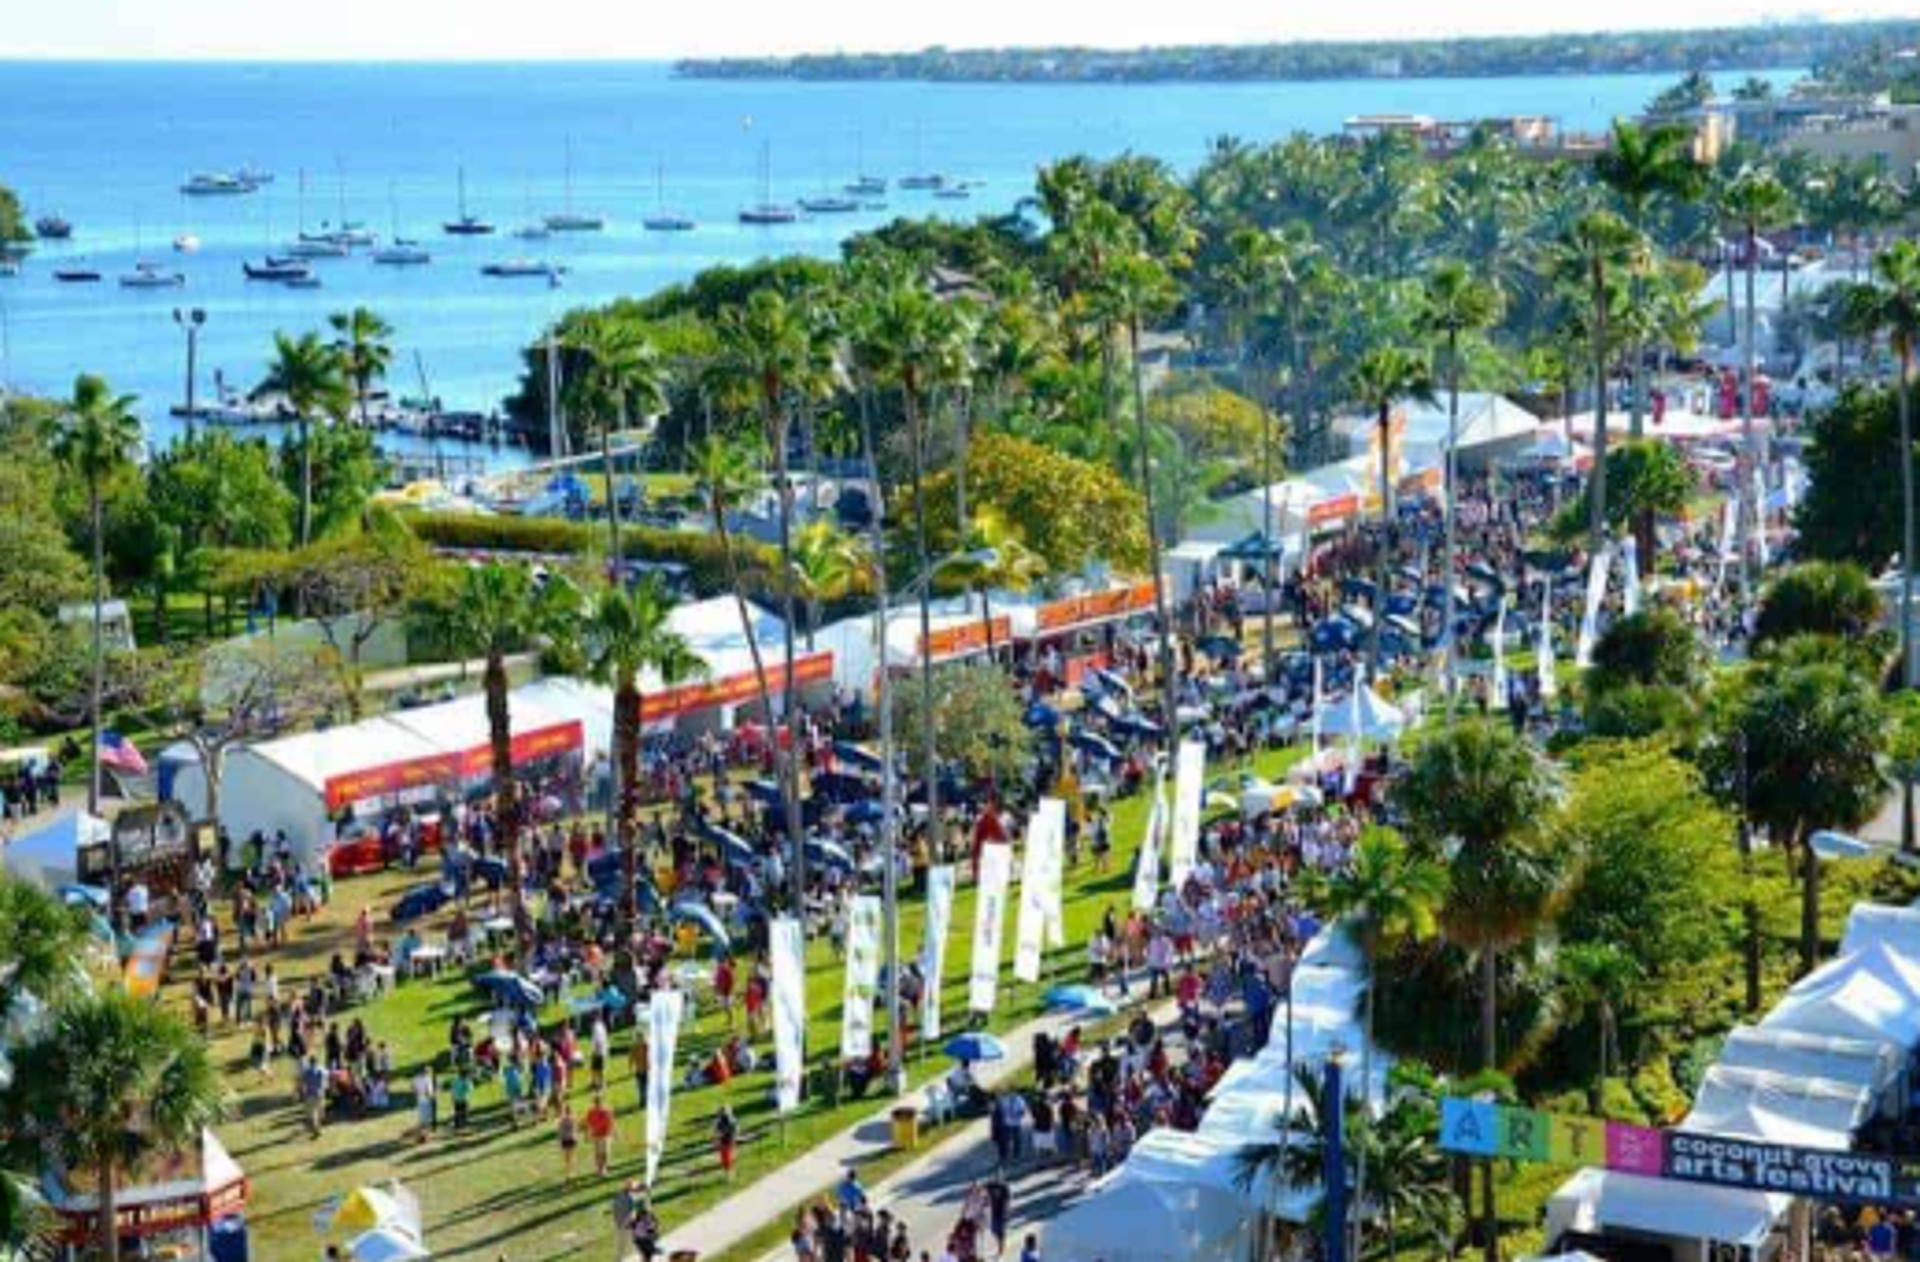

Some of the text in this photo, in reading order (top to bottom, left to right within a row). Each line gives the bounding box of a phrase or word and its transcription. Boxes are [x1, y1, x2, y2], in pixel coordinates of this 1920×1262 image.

[1671, 1136, 1795, 1167] coconut
[1804, 1154, 1891, 1177] grove
[1673, 1154, 1744, 1180] arts
[1754, 1158, 1891, 1198] festival
